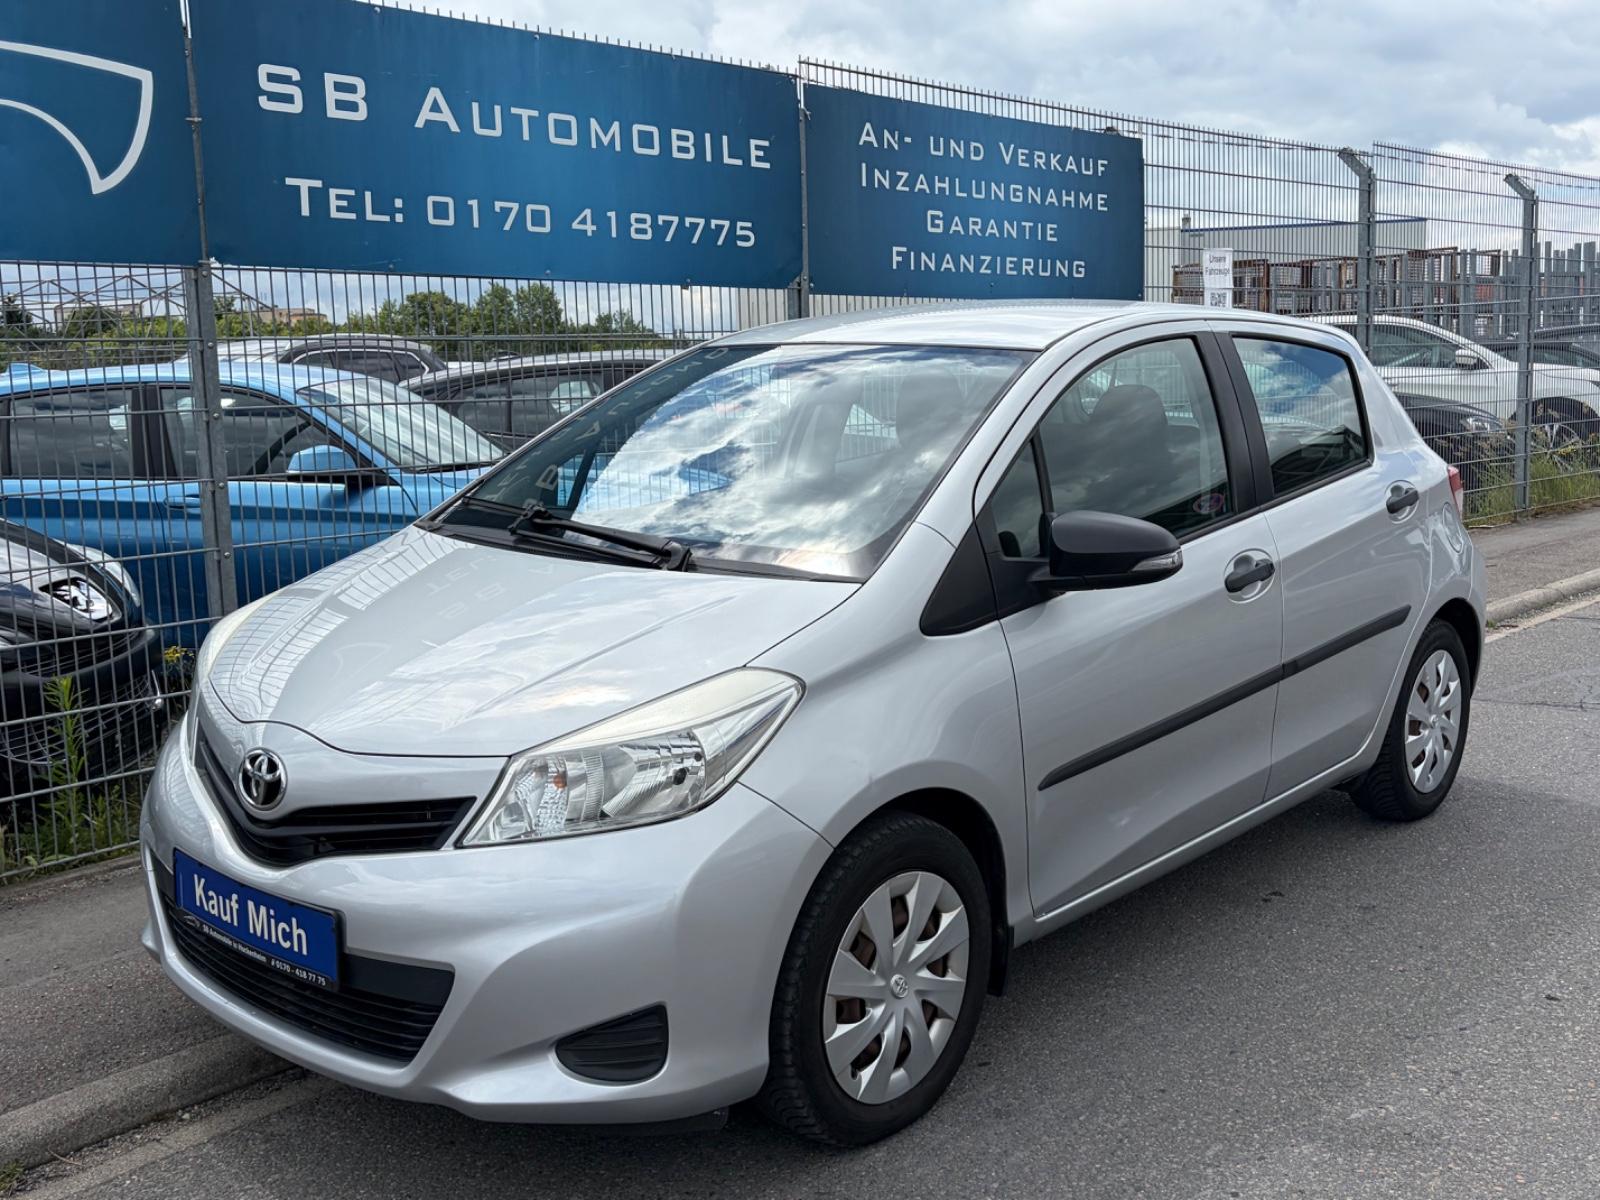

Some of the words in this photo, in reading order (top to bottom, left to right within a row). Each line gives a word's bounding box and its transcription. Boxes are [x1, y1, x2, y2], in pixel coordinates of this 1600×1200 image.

[257, 63, 368, 121] SB
[414, 86, 771, 169] AUTOMOBILE
[858, 121, 912, 151] AN-
[929, 135, 985, 161] UND
[998, 142, 1109, 177] VERKAUF
[284, 176, 404, 223] TEL:
[426, 195, 551, 234] 0170
[571, 208, 755, 248] 4187775
[861, 162, 1108, 212] INZAHLUNGNAHME
[926, 209, 1058, 242] GARANTIE
[892, 245, 1086, 278] FINANZIERUNG
[193, 873, 239, 927] Kauf
[247, 899, 308, 956] Mich
[275, 959, 291, 973] 0170
[295, 967, 308, 979] 418
[308, 972, 317, 982] 77
[317, 976, 327, 986] 75
